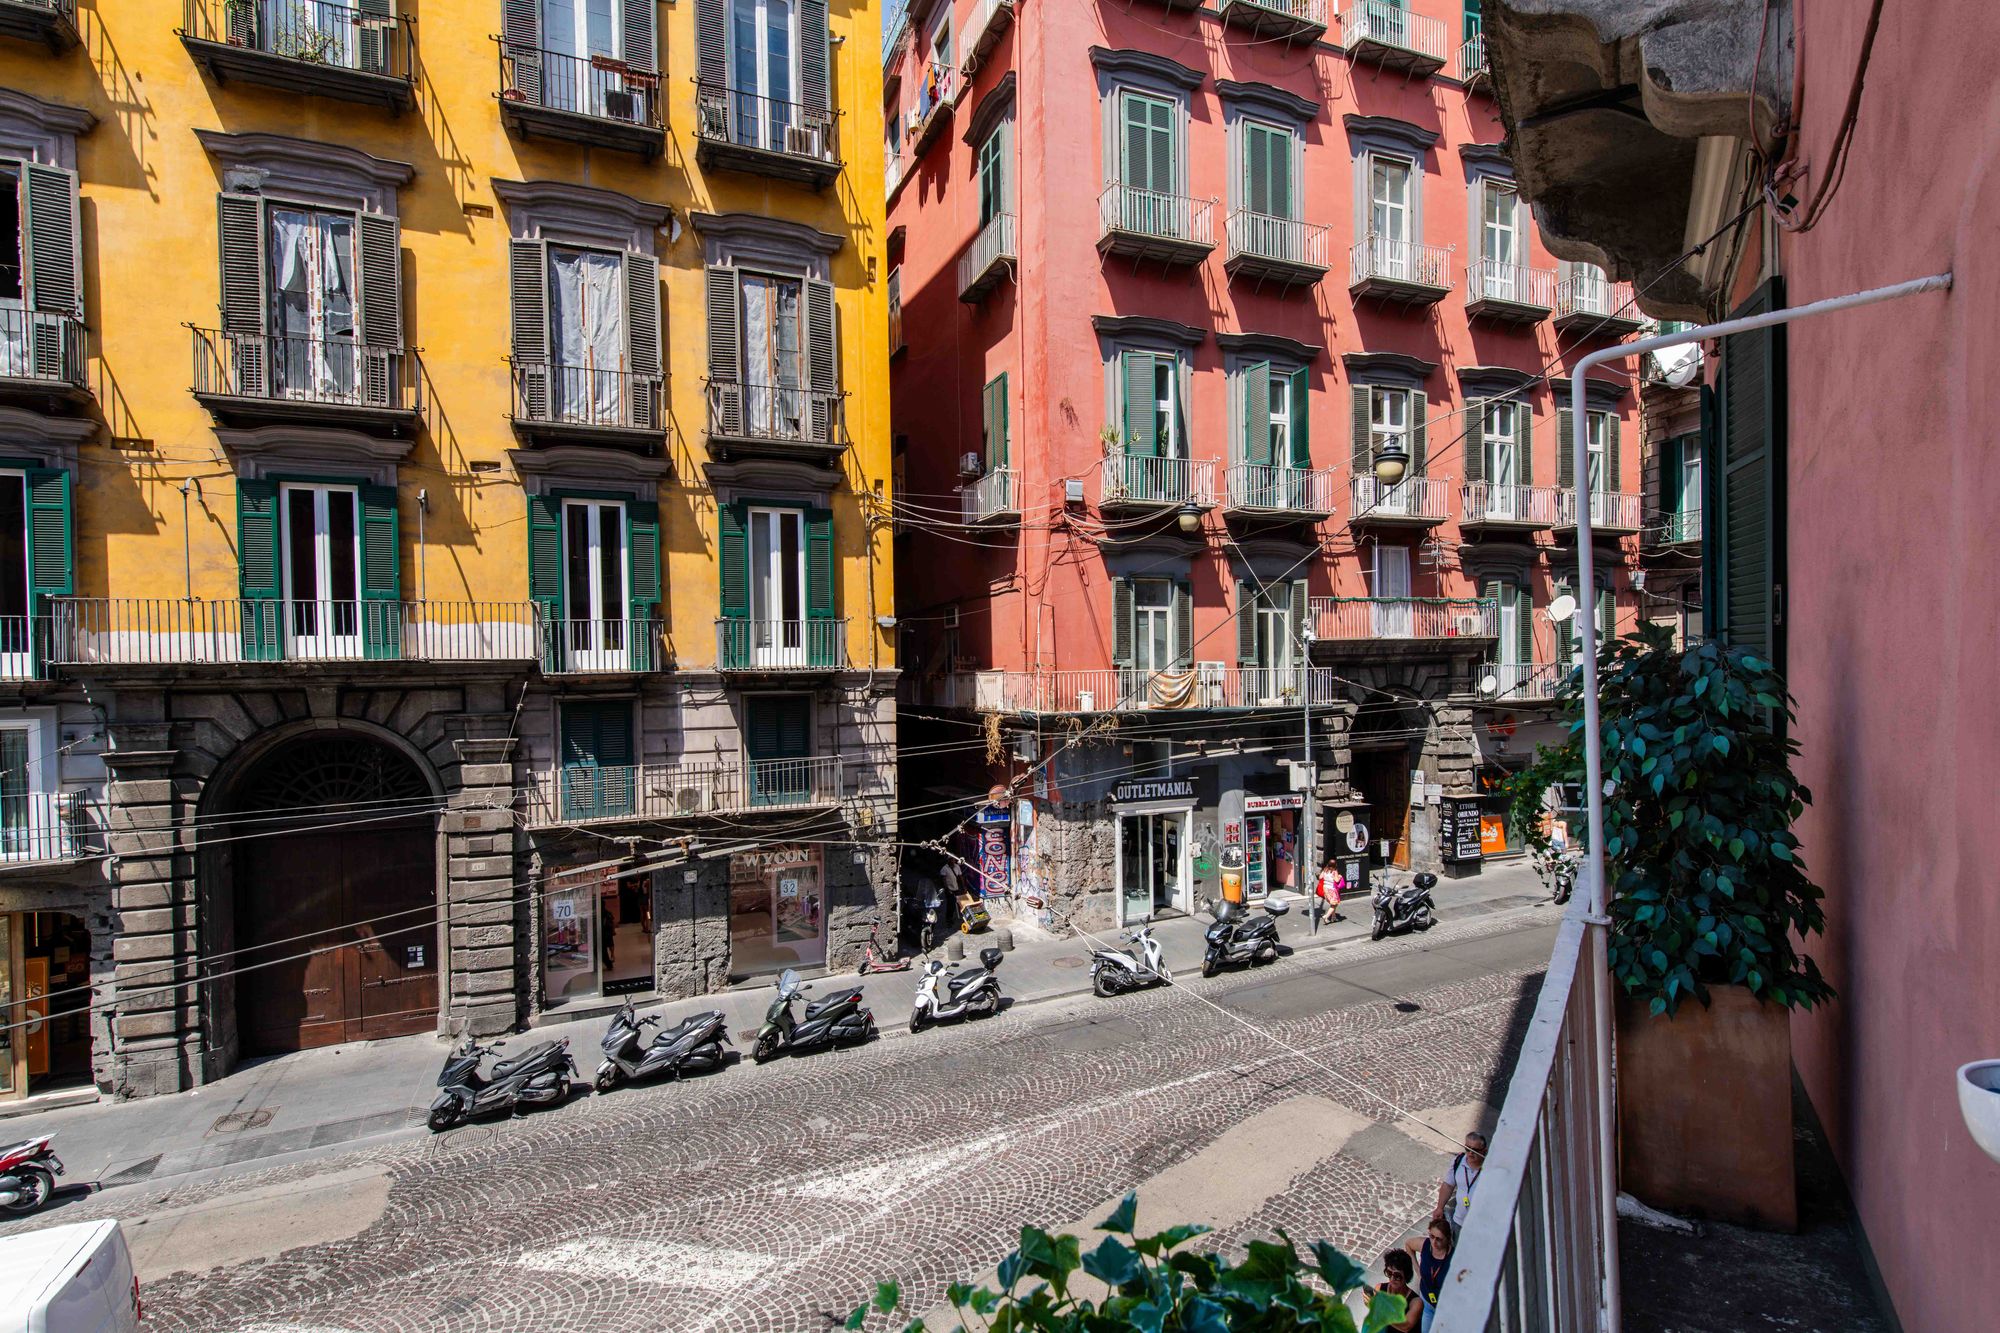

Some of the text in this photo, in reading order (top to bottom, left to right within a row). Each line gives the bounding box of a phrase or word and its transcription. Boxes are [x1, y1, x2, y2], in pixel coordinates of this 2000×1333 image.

[1117, 782, 1193, 800] OUTLETMANIA
[1247, 798, 1301, 808] BUBBLE TEA POKE
[743, 849, 810, 867] WYCON
